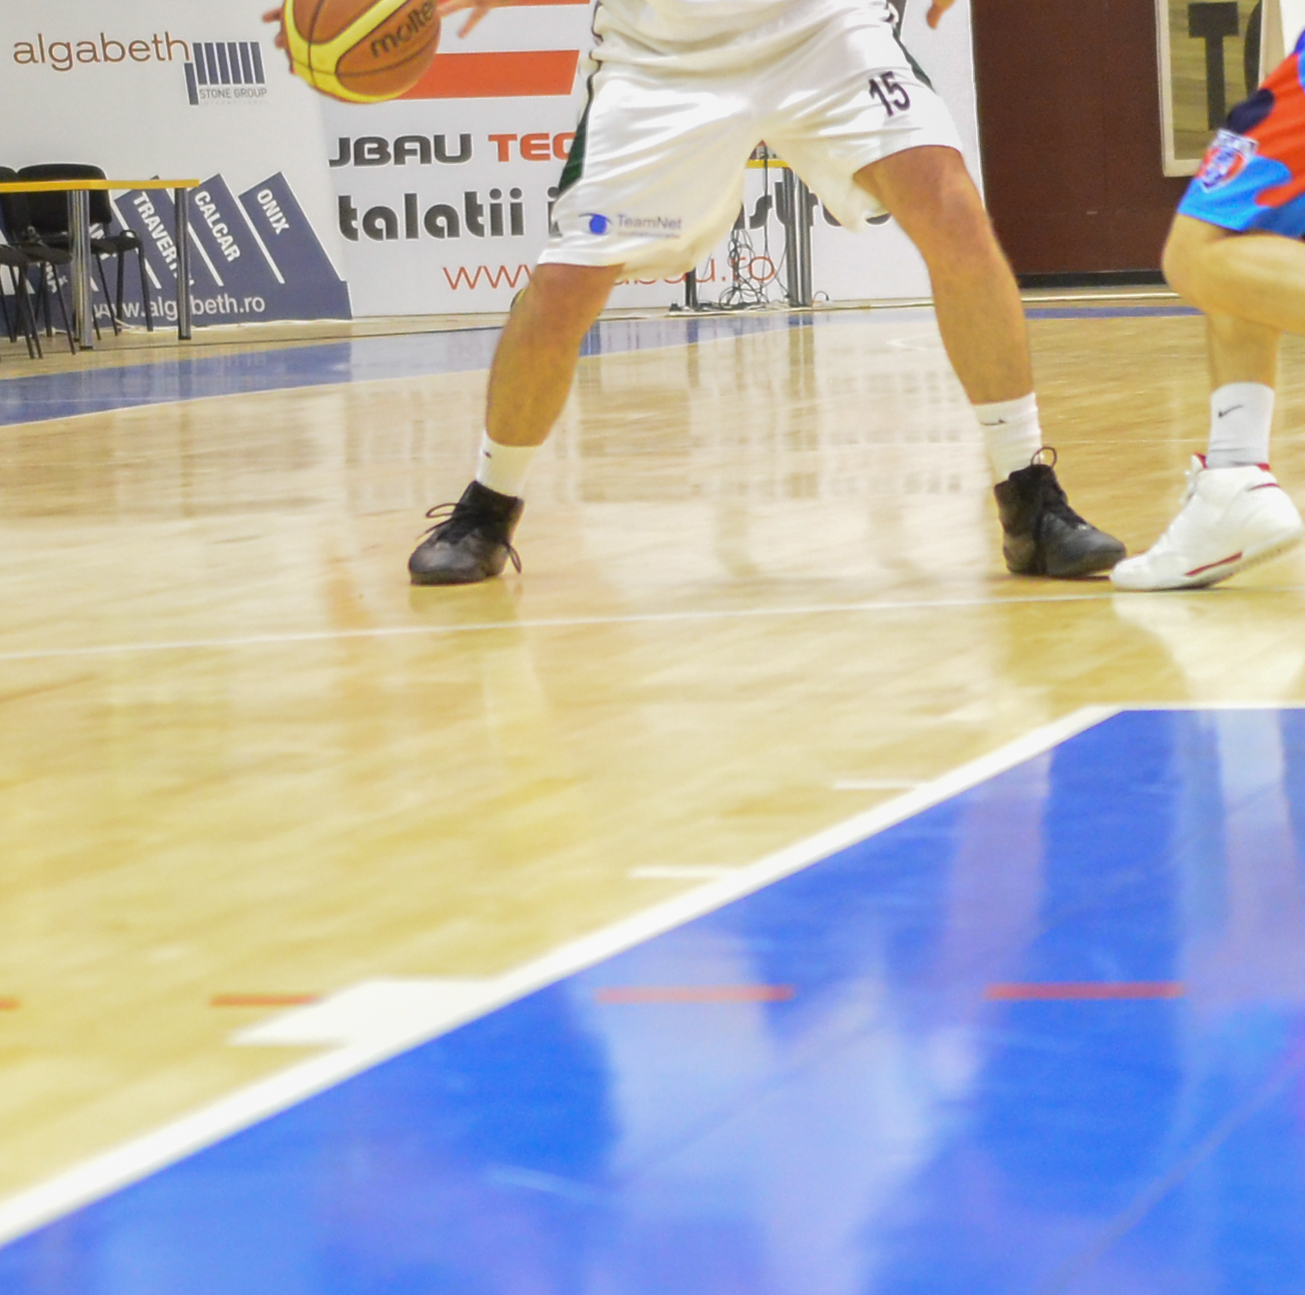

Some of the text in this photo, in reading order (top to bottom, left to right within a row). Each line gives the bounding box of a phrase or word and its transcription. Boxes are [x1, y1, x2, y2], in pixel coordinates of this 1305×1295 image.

[12, 32, 191, 71] algabeth
[199, 88, 267, 99] STONE GROUP
[868, 70, 910, 118] 15
[194, 190, 241, 263] CALCAR
[257, 188, 290, 235] ONIX
[618, 214, 681, 230] TeamNet
